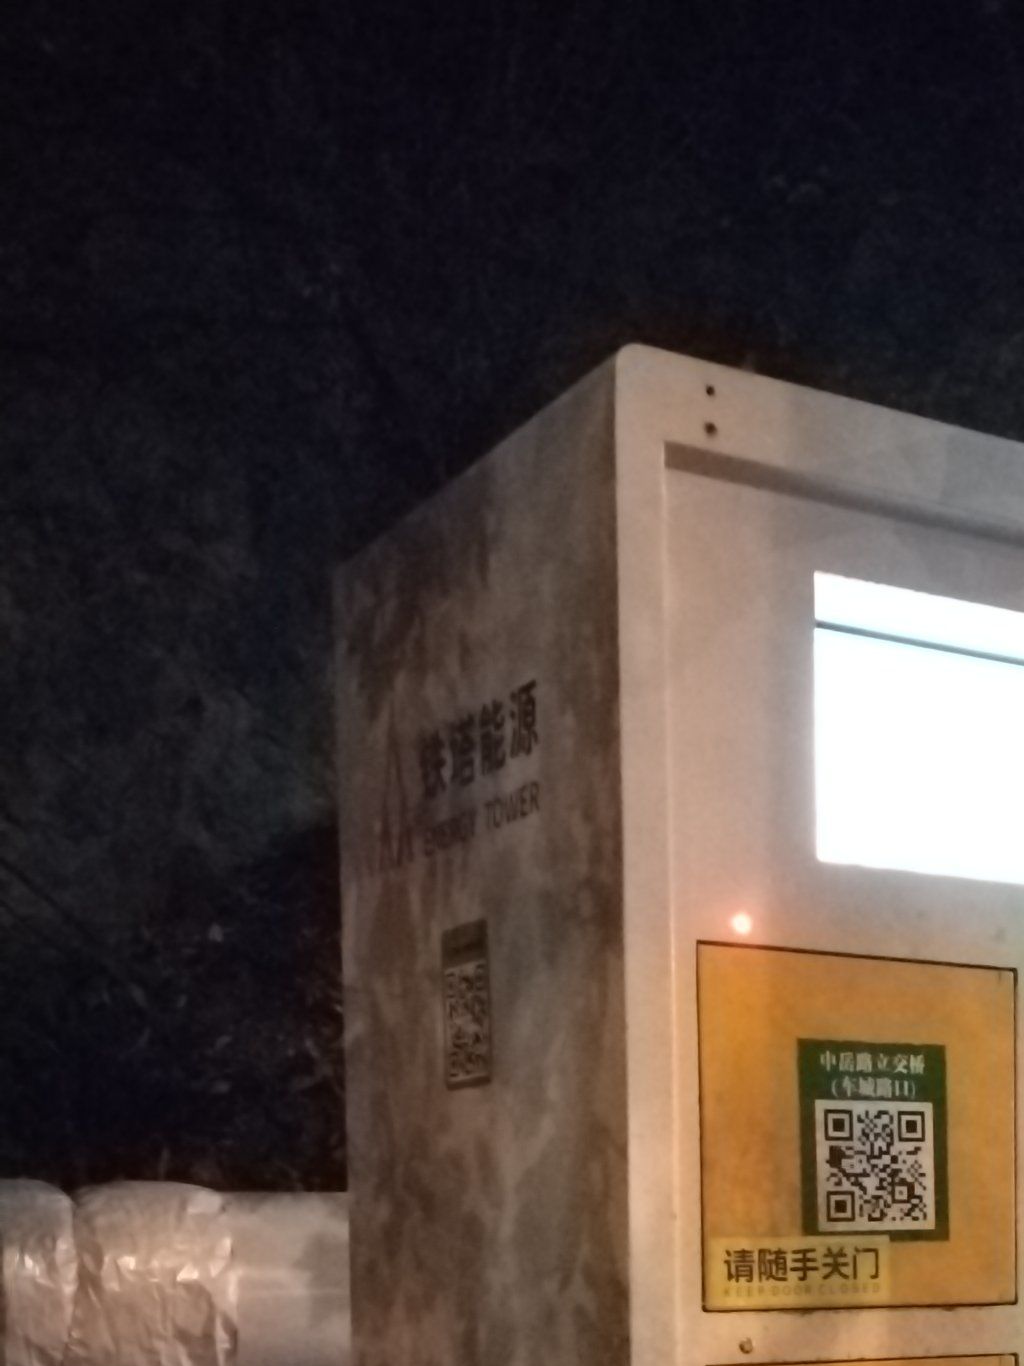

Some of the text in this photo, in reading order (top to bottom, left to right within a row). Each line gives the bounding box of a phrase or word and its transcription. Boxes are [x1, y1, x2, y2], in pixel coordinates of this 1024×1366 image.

[485, 781, 540, 830] TOWER
[723, 1246, 880, 1283] 请随手关门
